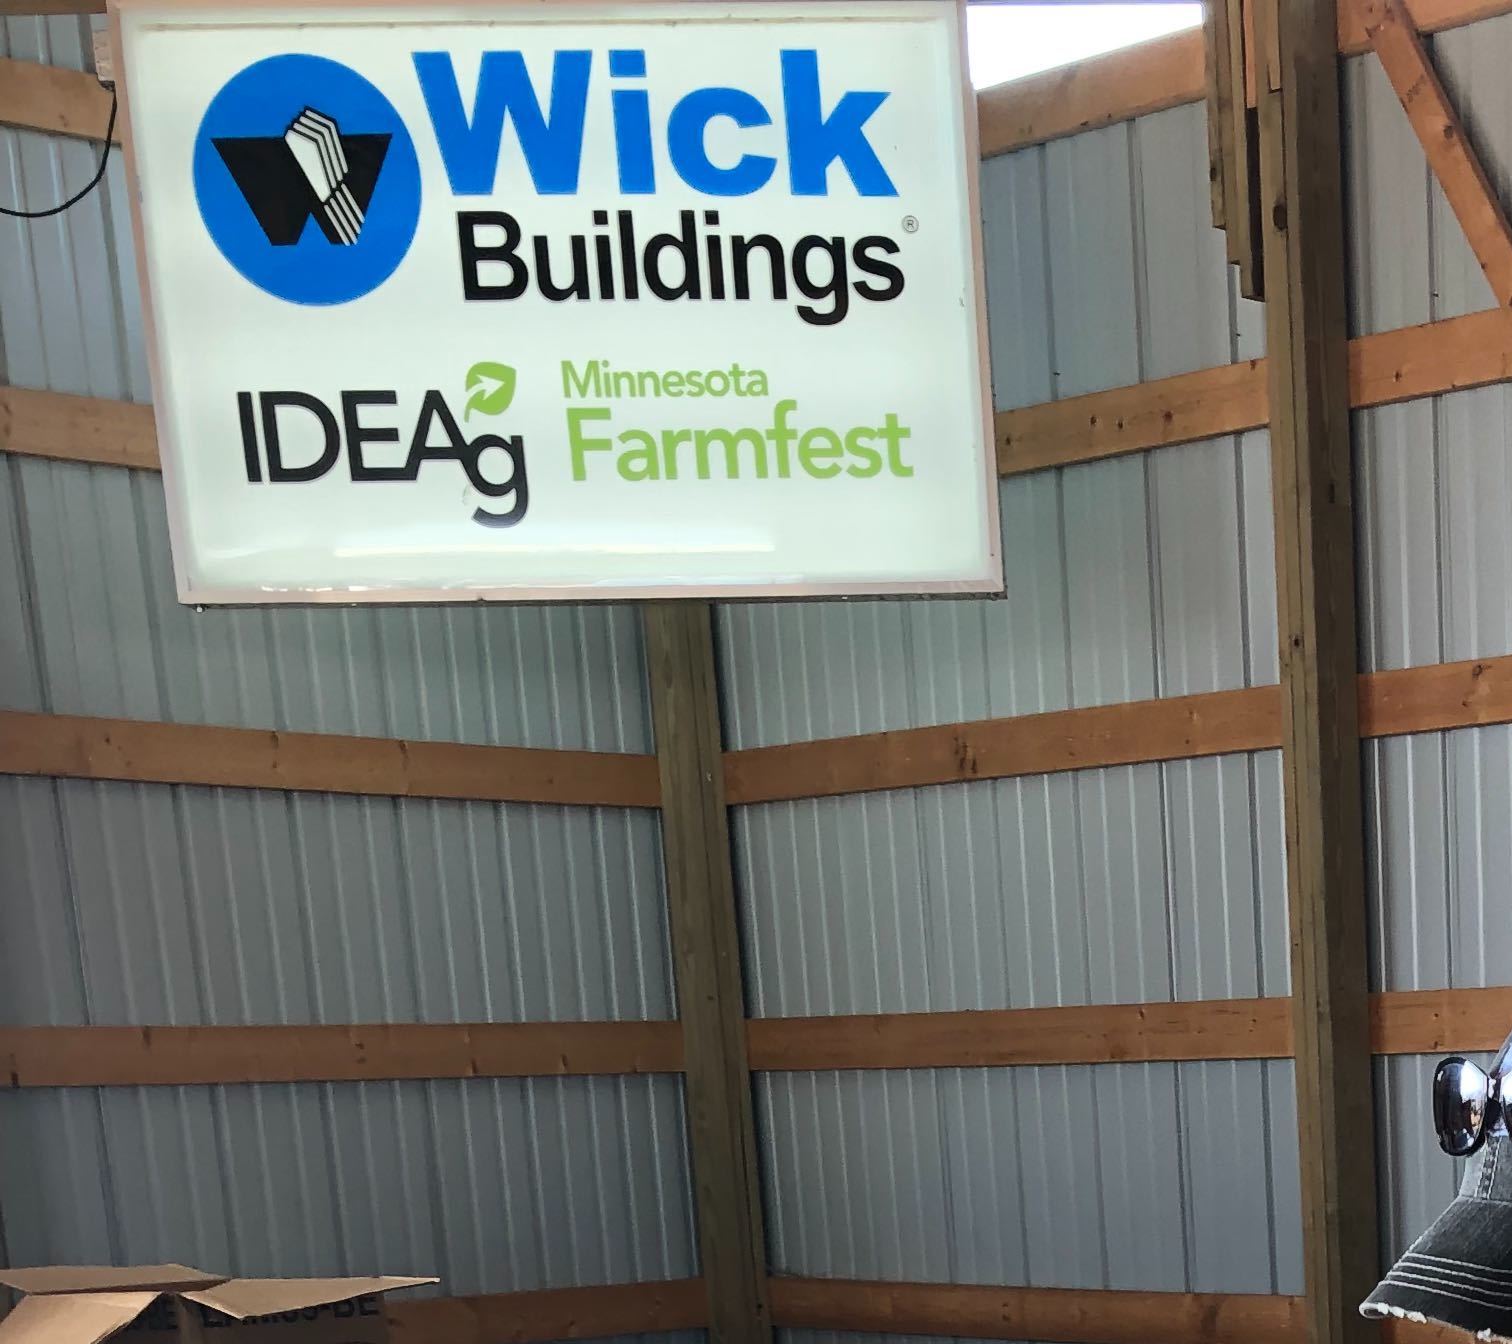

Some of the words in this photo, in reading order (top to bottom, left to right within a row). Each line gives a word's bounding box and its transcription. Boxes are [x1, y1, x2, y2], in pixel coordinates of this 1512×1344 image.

[412, 49, 899, 197] Wick
[562, 361, 769, 398] Minnesota
[236, 390, 529, 528] IDEAg
[566, 400, 914, 481] Farmfest
